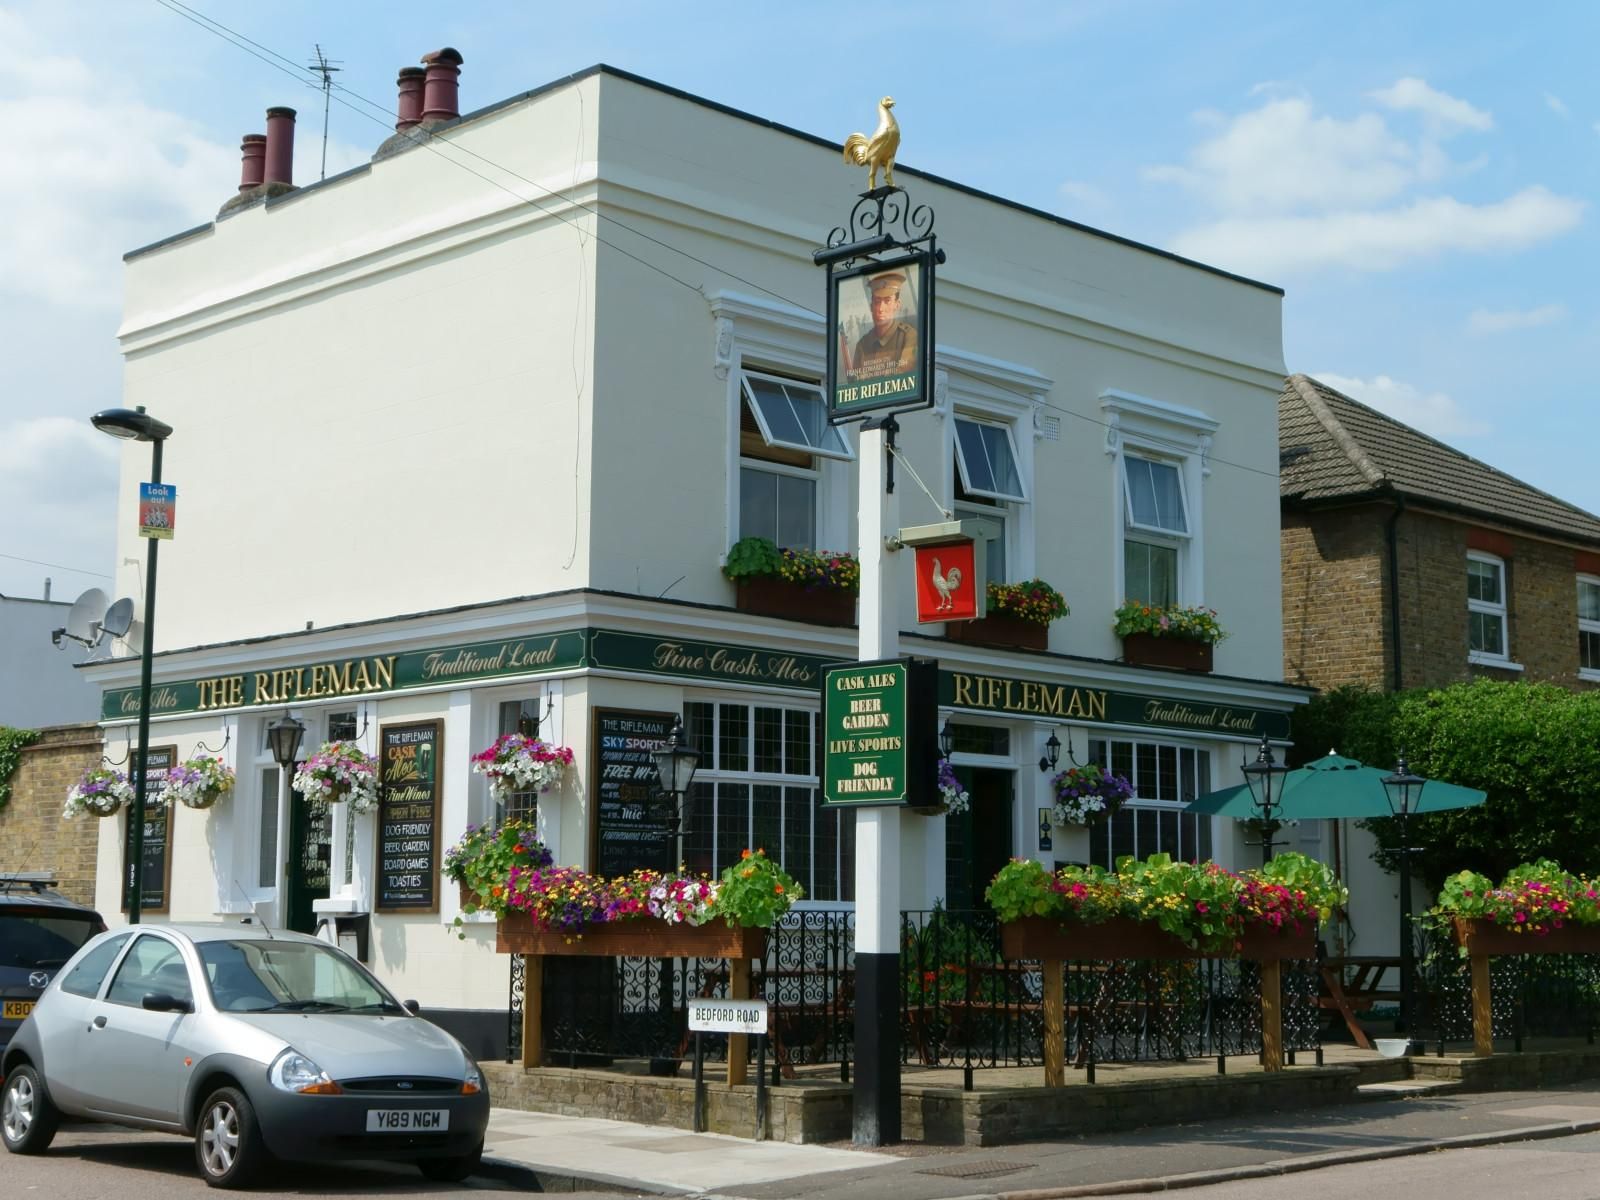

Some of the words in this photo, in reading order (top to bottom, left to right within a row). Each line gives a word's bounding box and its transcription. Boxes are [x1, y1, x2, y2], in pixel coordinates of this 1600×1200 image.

[838, 388, 858, 403] THE
[861, 376, 915, 399] RIFLEMAN
[147, 485, 169, 496] Look
[652, 642, 704, 669] Fine
[706, 647, 764, 677] Cask
[764, 657, 816, 681] Ales
[120, 692, 141, 712] Cas
[196, 676, 243, 710] THE
[254, 656, 396, 703] RIFLEMAN
[421, 645, 505, 680] Traditional
[506, 638, 558, 668] Local
[837, 676, 865, 691] CASK
[867, 673, 896, 688] ALES
[850, 698, 881, 713] BEER
[953, 673, 1107, 721] RIFLEMAN
[1144, 700, 1217, 726] Traditional
[1217, 709, 1257, 730] Local
[603, 720, 618, 731] THE
[620, 721, 664, 734] RIFLEMAN
[842, 713, 889, 729] GARDEN
[388, 734, 400, 744] THE
[402, 731, 433, 742] RIFLEMAN
[603, 736, 624, 748] SKY
[830, 740, 856, 753] LIVE
[858, 736, 902, 752] SPORTS
[388, 745, 416, 760] CASK
[384, 757, 414, 780] Ales
[603, 764, 633, 778] FREE
[853, 762, 877, 776] DOG
[837, 777, 893, 792] FRIENDLY
[404, 786, 431, 800] Wines
[385, 825, 401, 836] DOG
[402, 823, 431, 835] FRIENDLY
[384, 842, 400, 853] BEER
[402, 841, 430, 852] GARDEN
[384, 859, 405, 870] BOARD
[406, 858, 428, 869] GAMES
[388, 875, 421, 888] TOASTIES
[5, 1001, 36, 1016] KB0
[696, 1008, 734, 1022] BEDFORD
[736, 1009, 760, 1023] ROAD
[377, 1111, 409, 1128] Y189
[412, 1111, 440, 1128] NGM
